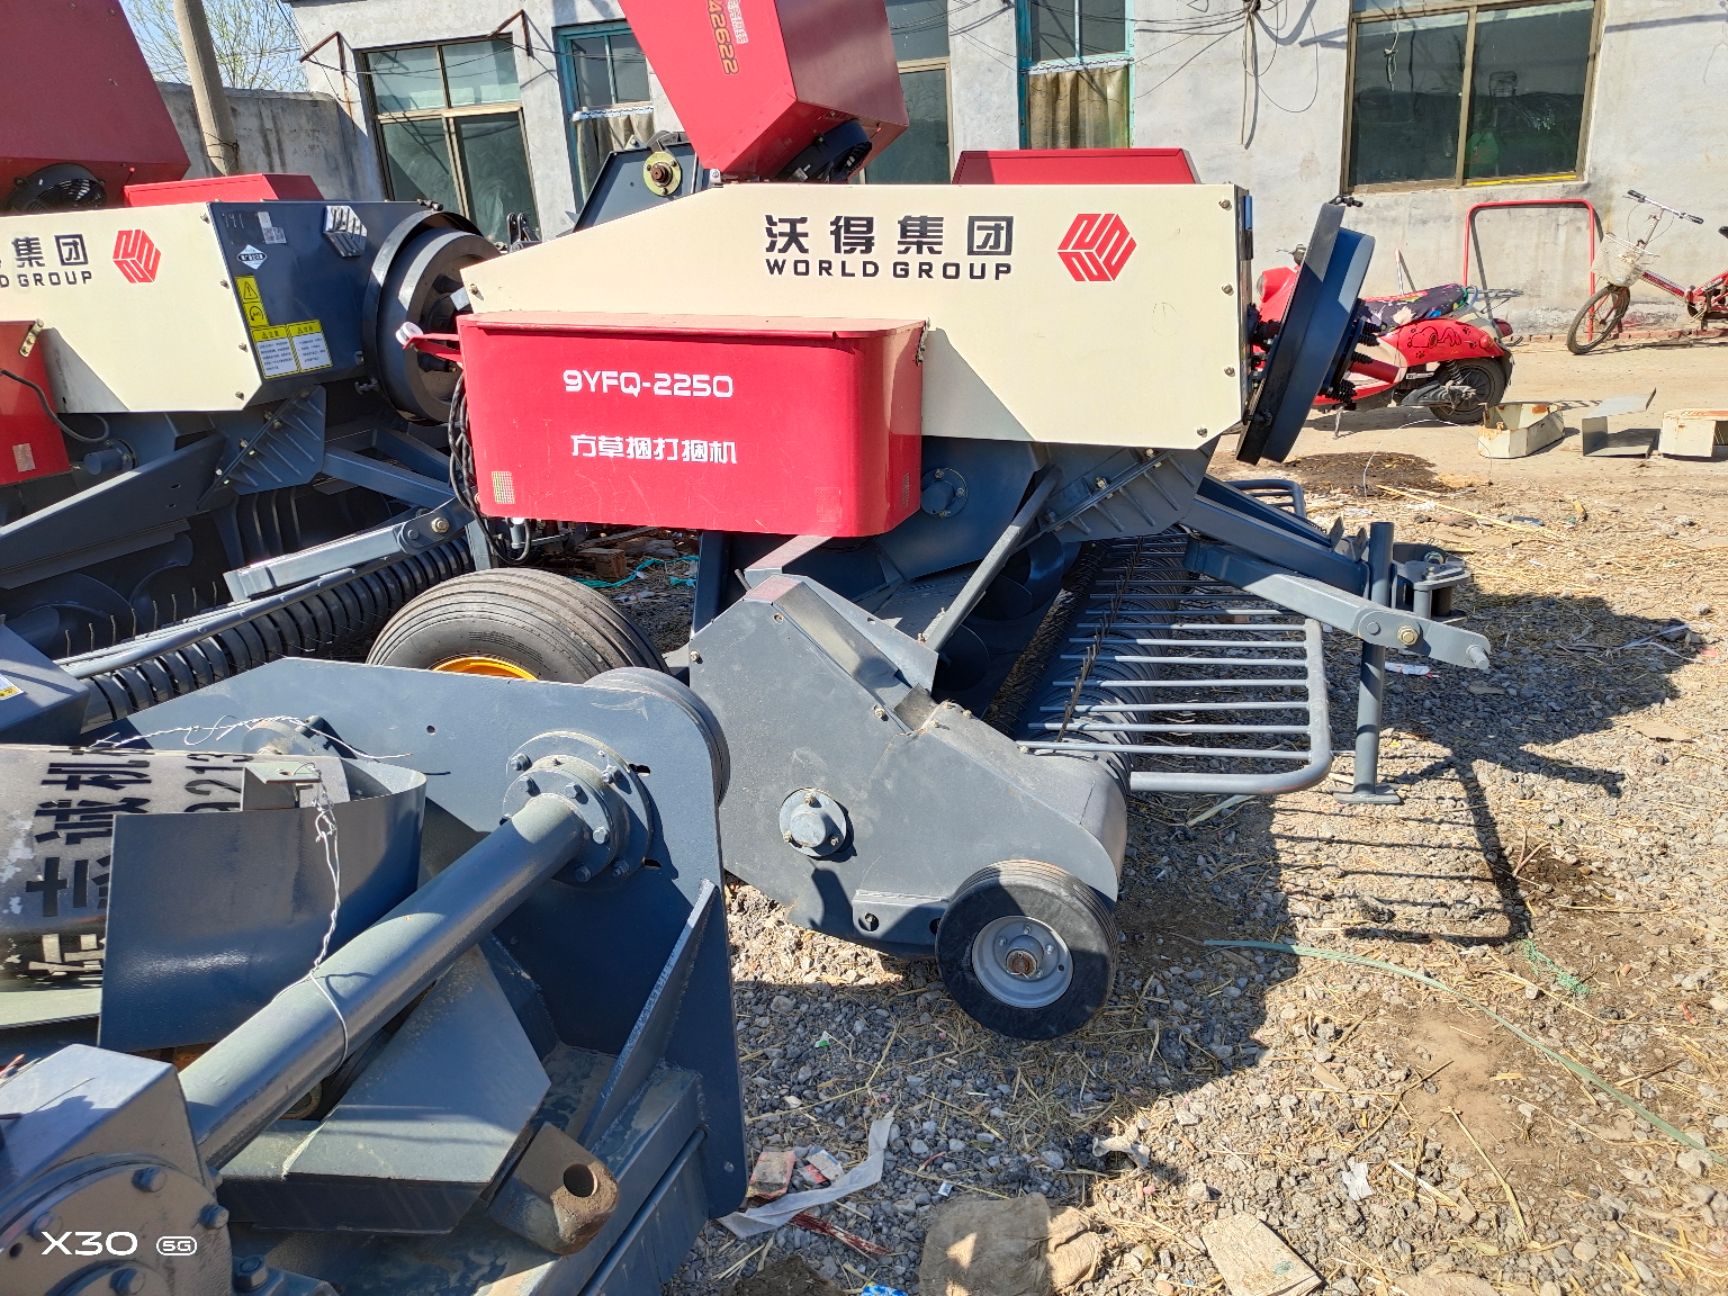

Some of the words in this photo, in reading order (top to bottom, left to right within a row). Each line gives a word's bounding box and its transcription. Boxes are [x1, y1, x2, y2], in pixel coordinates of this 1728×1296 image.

[765, 214, 1014, 256] 沃得集团
[0, 234, 89, 268] 集团
[17, 270, 92, 288] GROUP
[765, 258, 880, 278] WORLD
[892, 261, 1012, 281] GROUP
[562, 369, 735, 398] 9YFQ-2250
[570, 434, 737, 464] 方草捆打捆机
